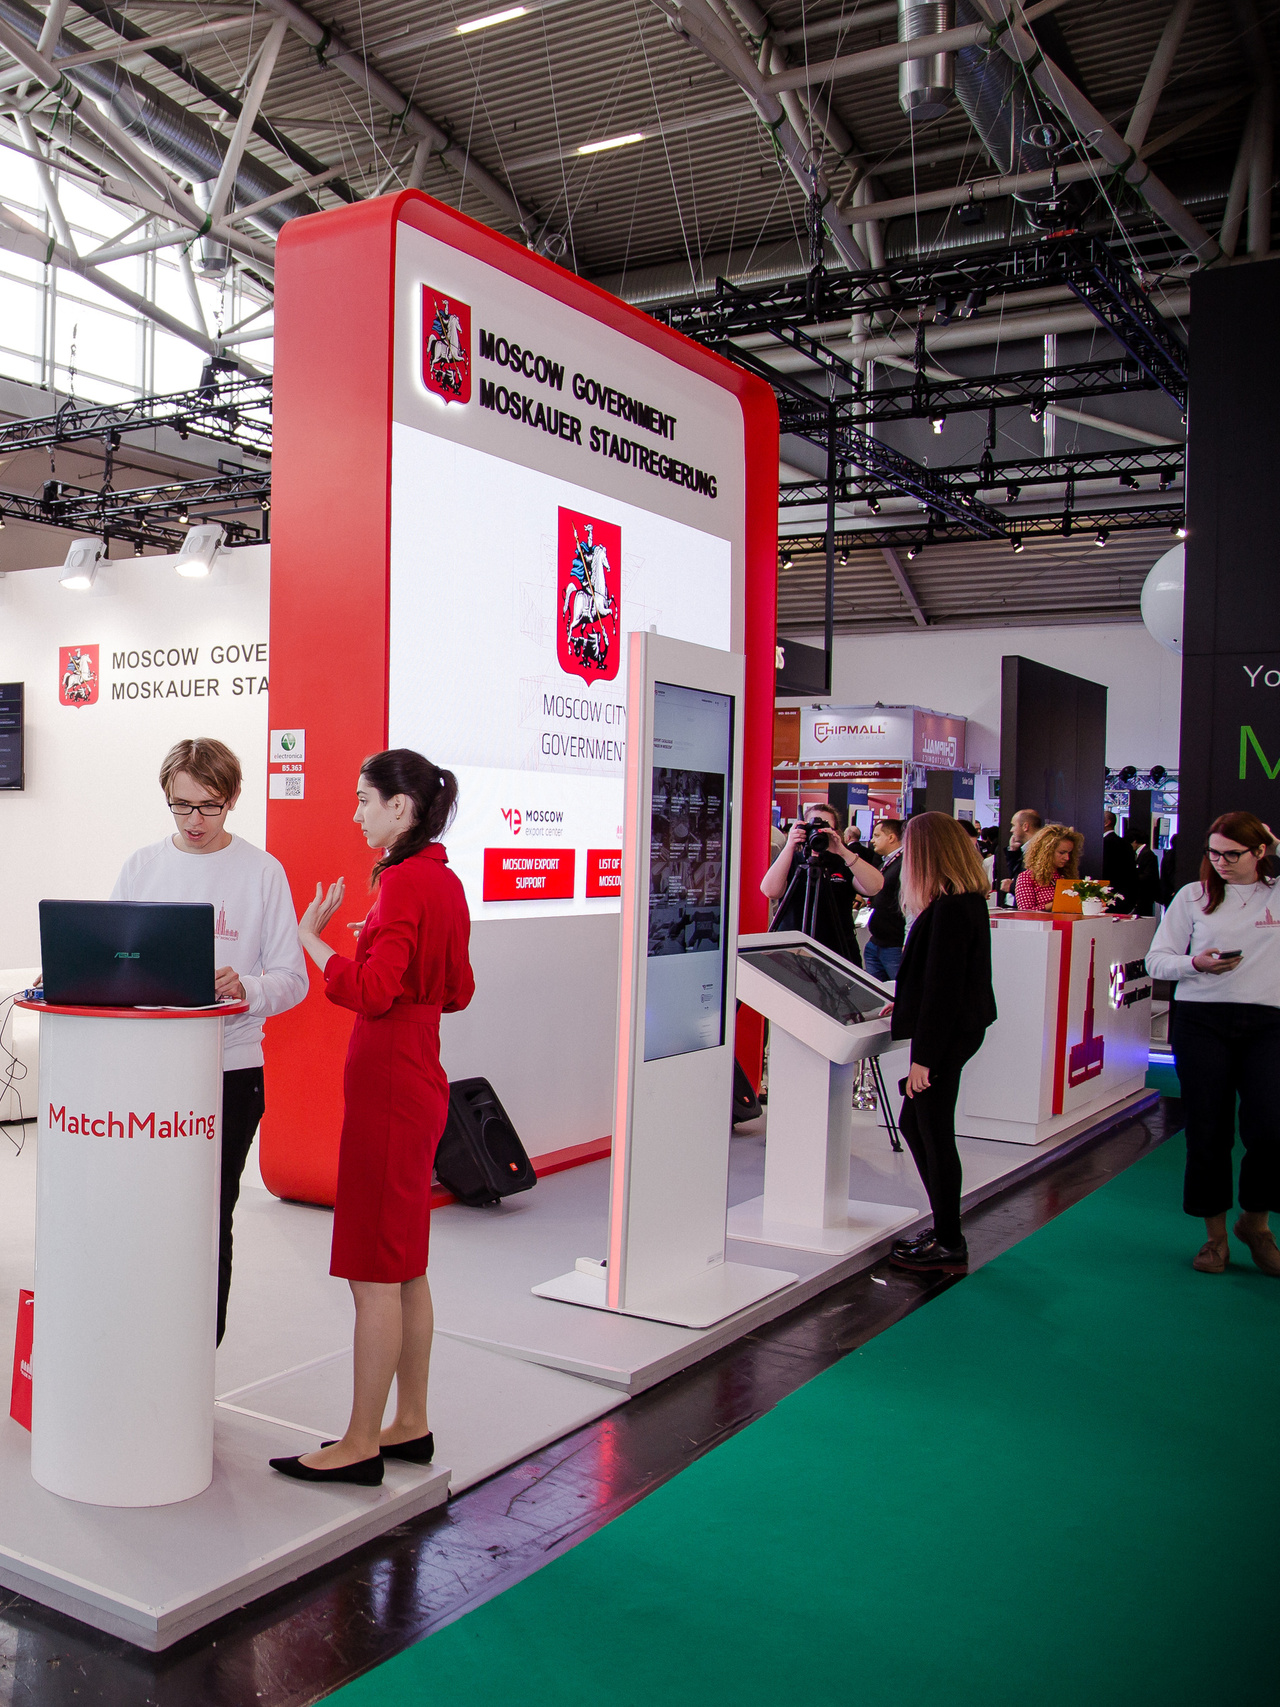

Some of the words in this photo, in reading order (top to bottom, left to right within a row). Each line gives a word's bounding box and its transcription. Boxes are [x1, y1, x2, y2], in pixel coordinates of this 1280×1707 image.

[479, 329, 564, 390] MOSCOW
[572, 373, 677, 441] GOVERNMENT
[479, 378, 582, 445] MOSKAUER
[590, 425, 717, 499] STADTREGIERUNG
[112, 648, 199, 669] MOSCOW
[211, 644, 267, 663] GOVE
[1243, 665, 1280, 687] Yo
[112, 679, 219, 700] MOSKAUER
[231, 677, 269, 696] STA
[544, 694, 602, 722] MOSCOW
[818, 725, 885, 735] CHIPMALL
[542, 733, 626, 761] GOVERNMEN
[1239, 725, 1280, 779] M
[526, 810, 563, 822] MOSCOW
[526, 828, 544, 836] export
[546, 828, 563, 836] center
[503, 859, 534, 870] MOSCOW
[535, 858, 560, 870] EXPORT
[599, 859, 610, 869] LIST
[516, 877, 546, 888] SUPPORT
[49, 1103, 216, 1140] MatchMaking
